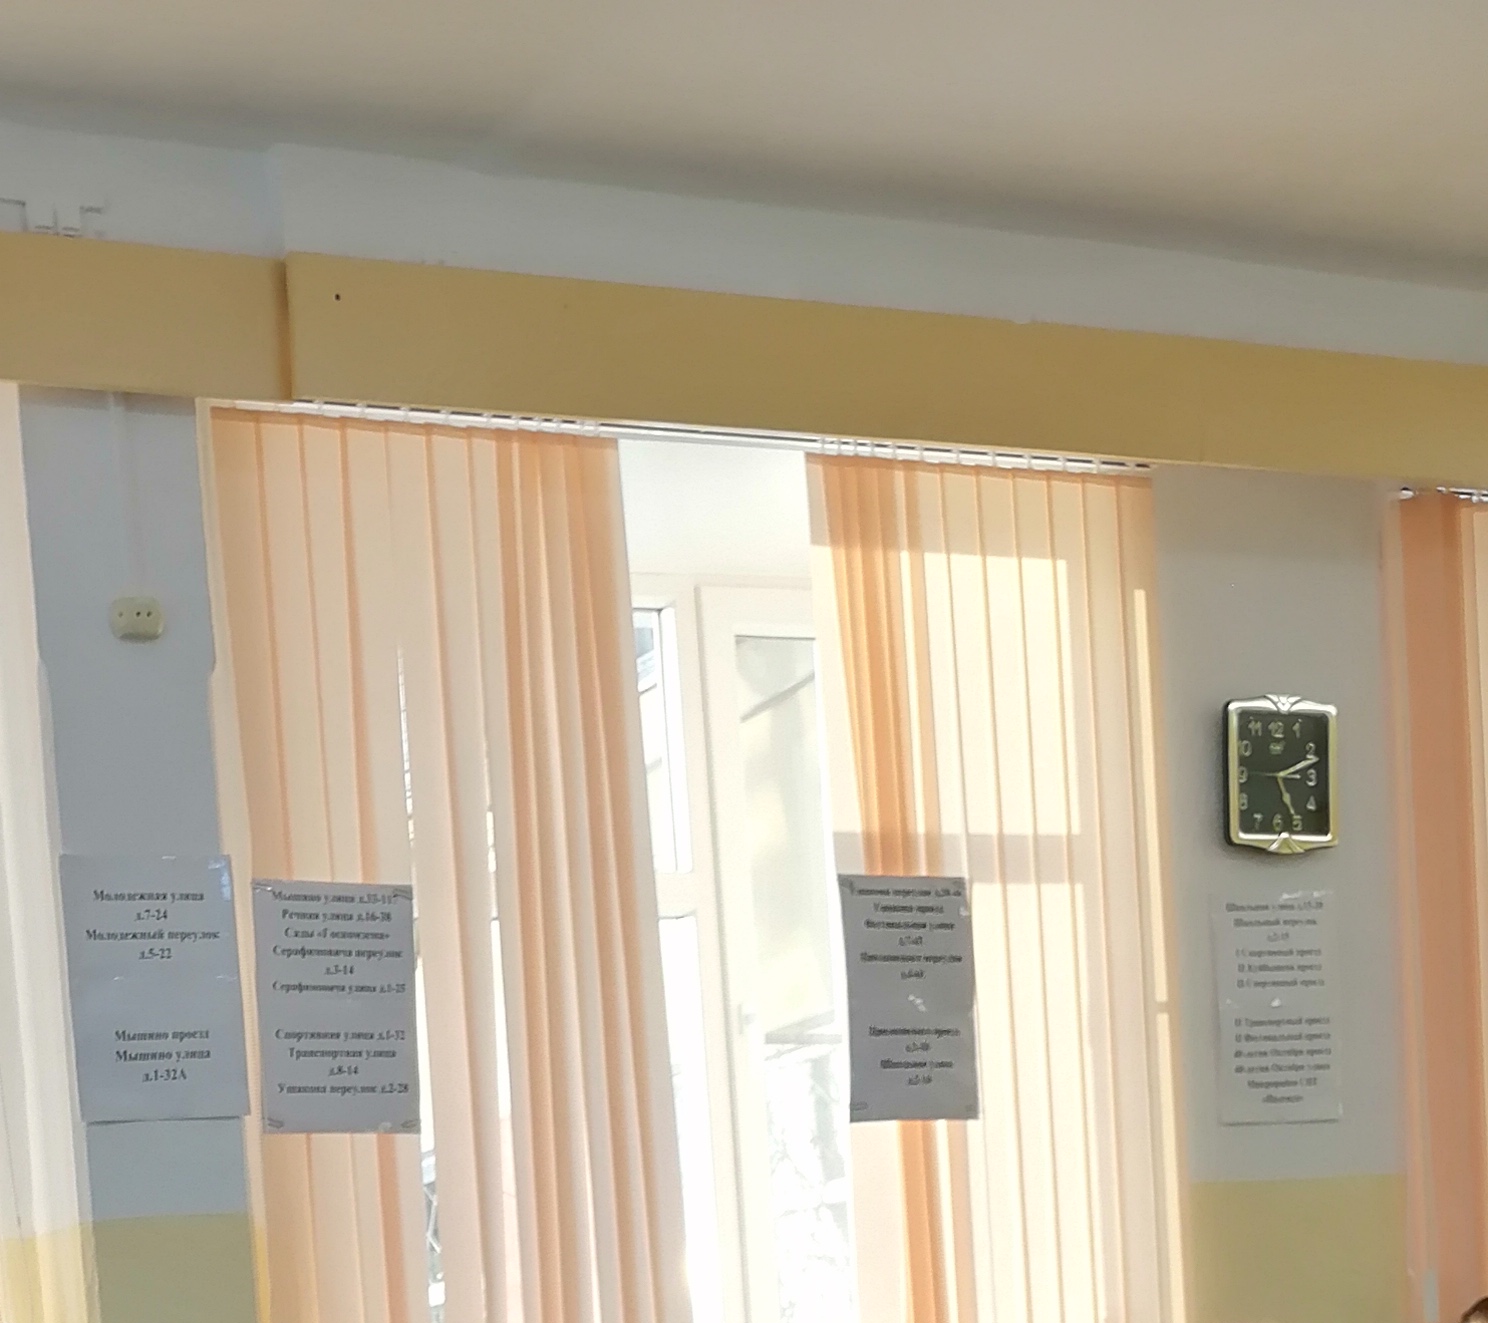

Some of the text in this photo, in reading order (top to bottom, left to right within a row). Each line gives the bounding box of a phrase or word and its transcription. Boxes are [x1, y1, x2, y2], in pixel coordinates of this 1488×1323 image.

[1268, 721, 1284, 738] 12
[1306, 769, 1317, 786] 3
[170, 893, 204, 903] улица
